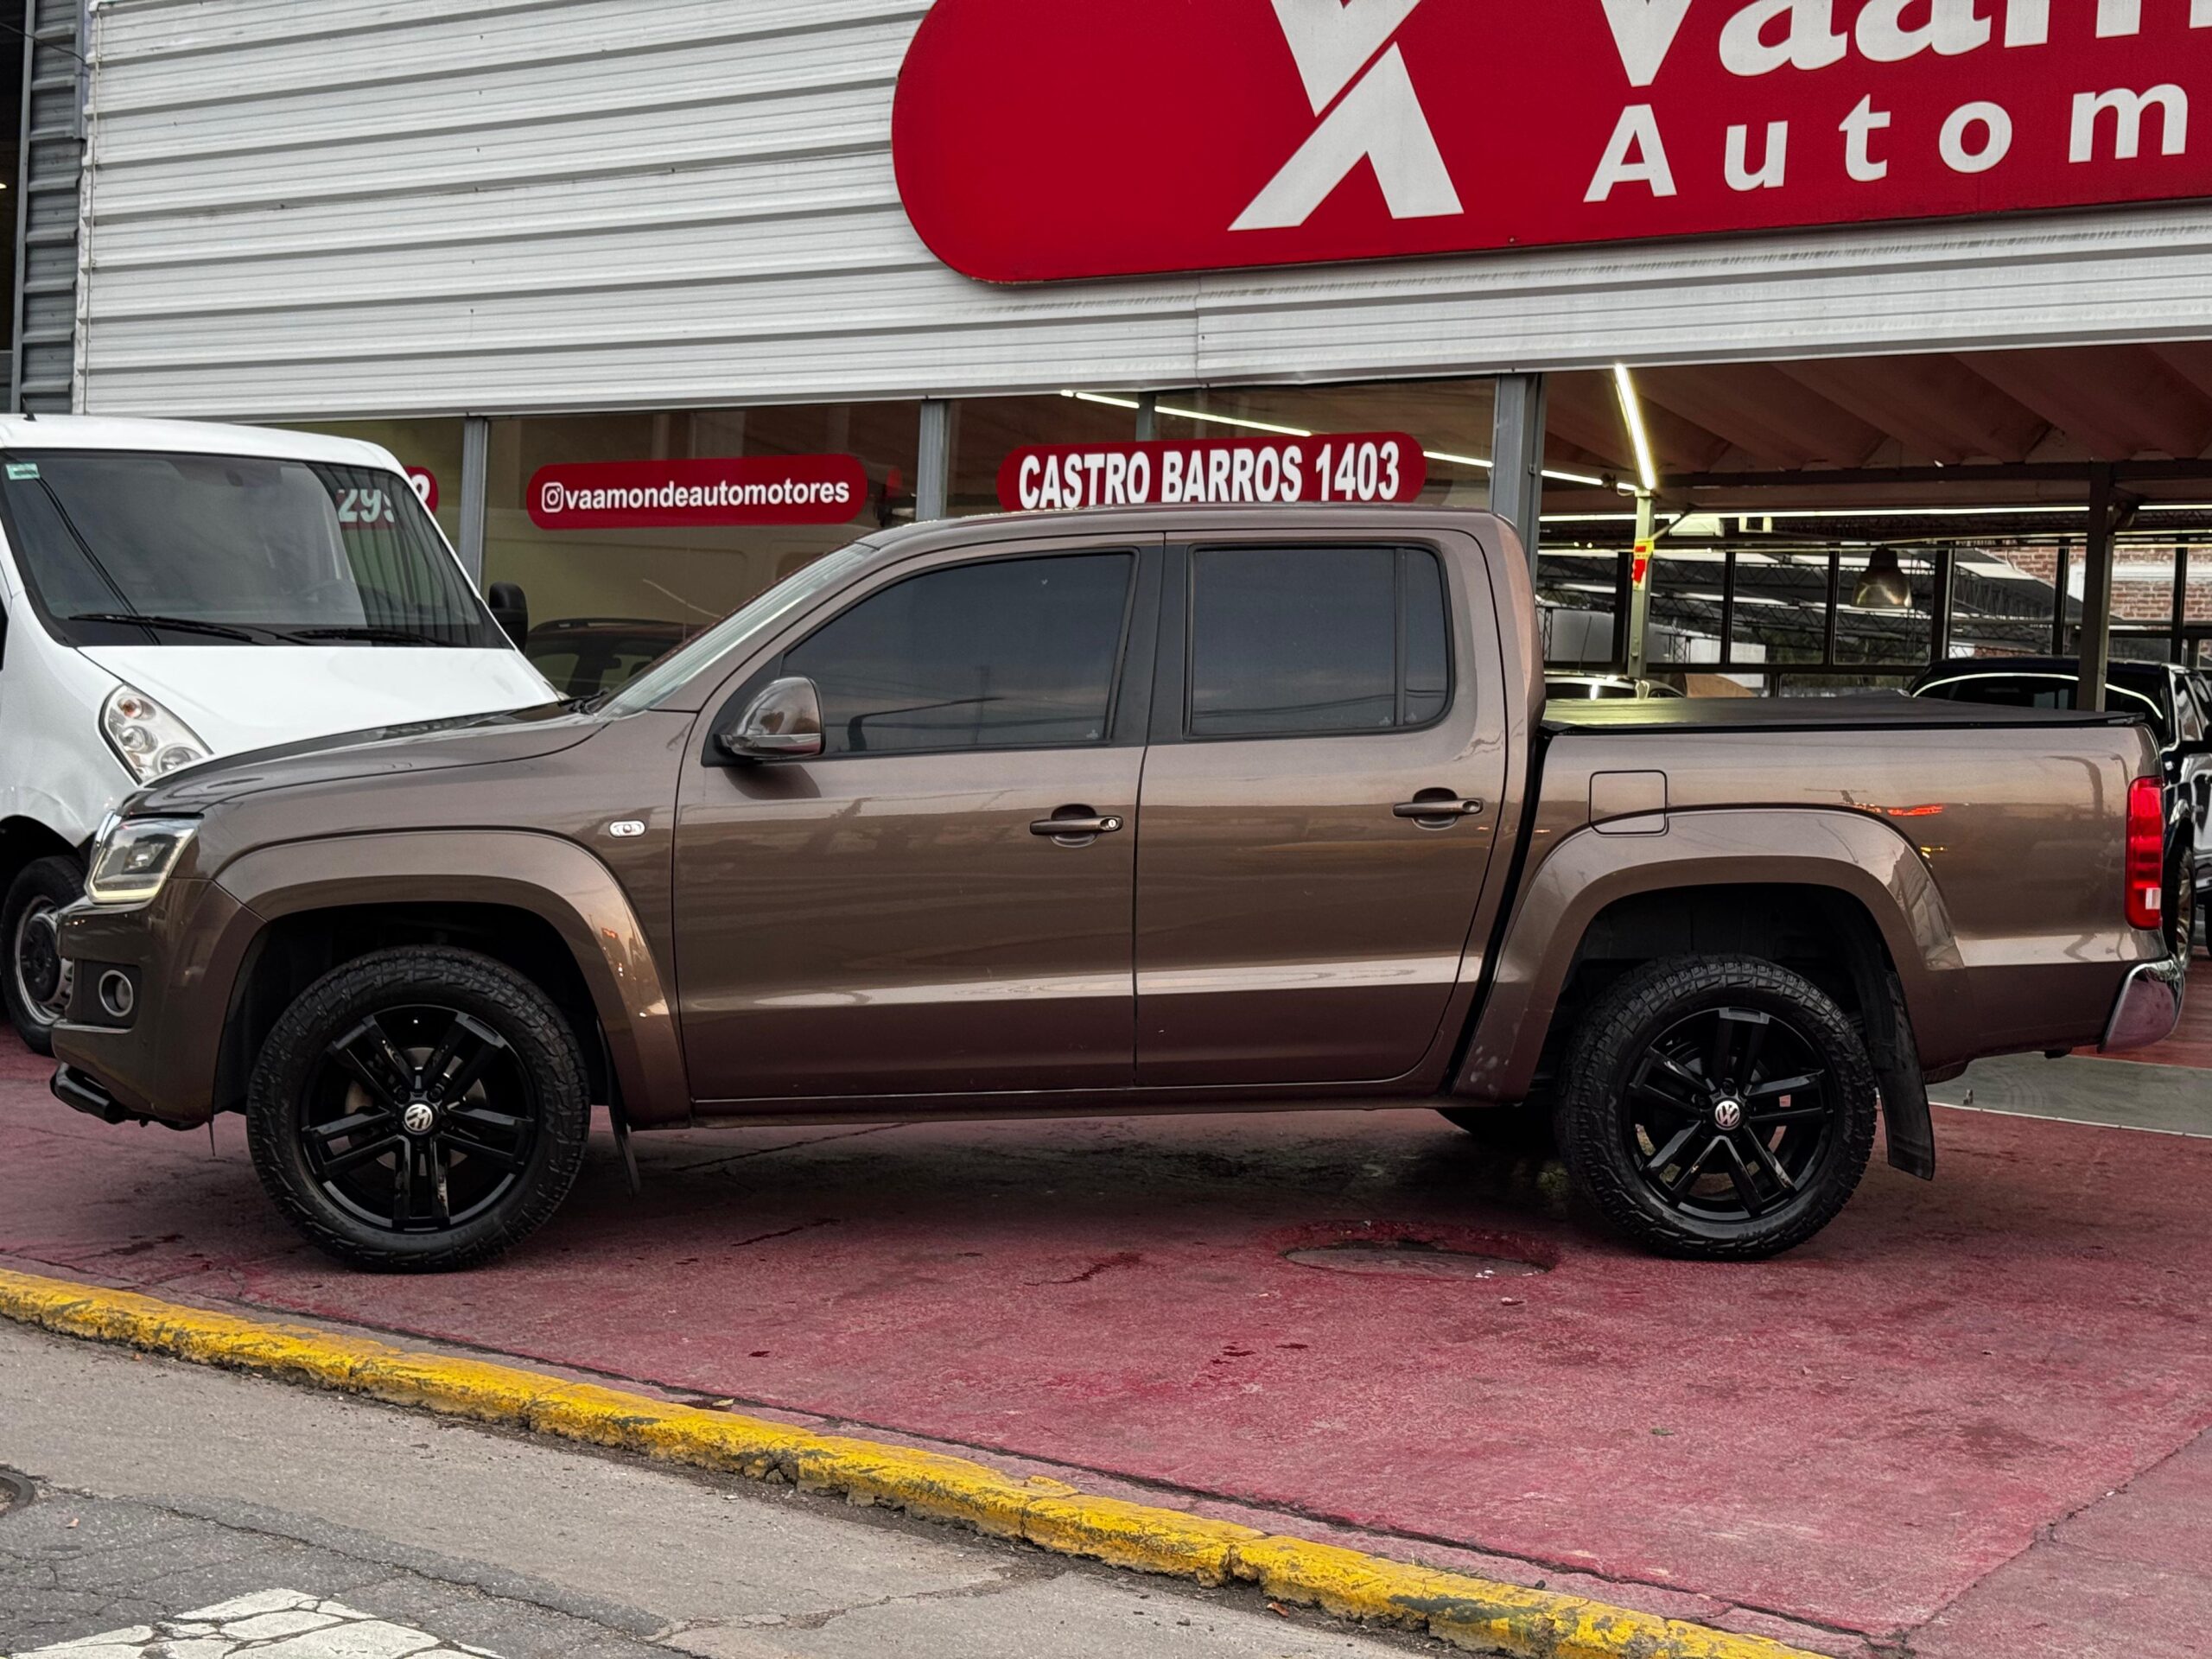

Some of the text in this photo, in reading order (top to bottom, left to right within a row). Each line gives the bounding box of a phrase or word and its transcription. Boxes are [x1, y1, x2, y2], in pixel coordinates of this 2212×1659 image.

[1601, 0, 2212, 86] Vaa
[1583, 84, 2188, 202] Autom
[564, 478, 850, 511] vaamondeautomotores
[1019, 441, 1400, 509] CASTRO BARROS 1403
[1715, 1100, 1740, 1127] VW
